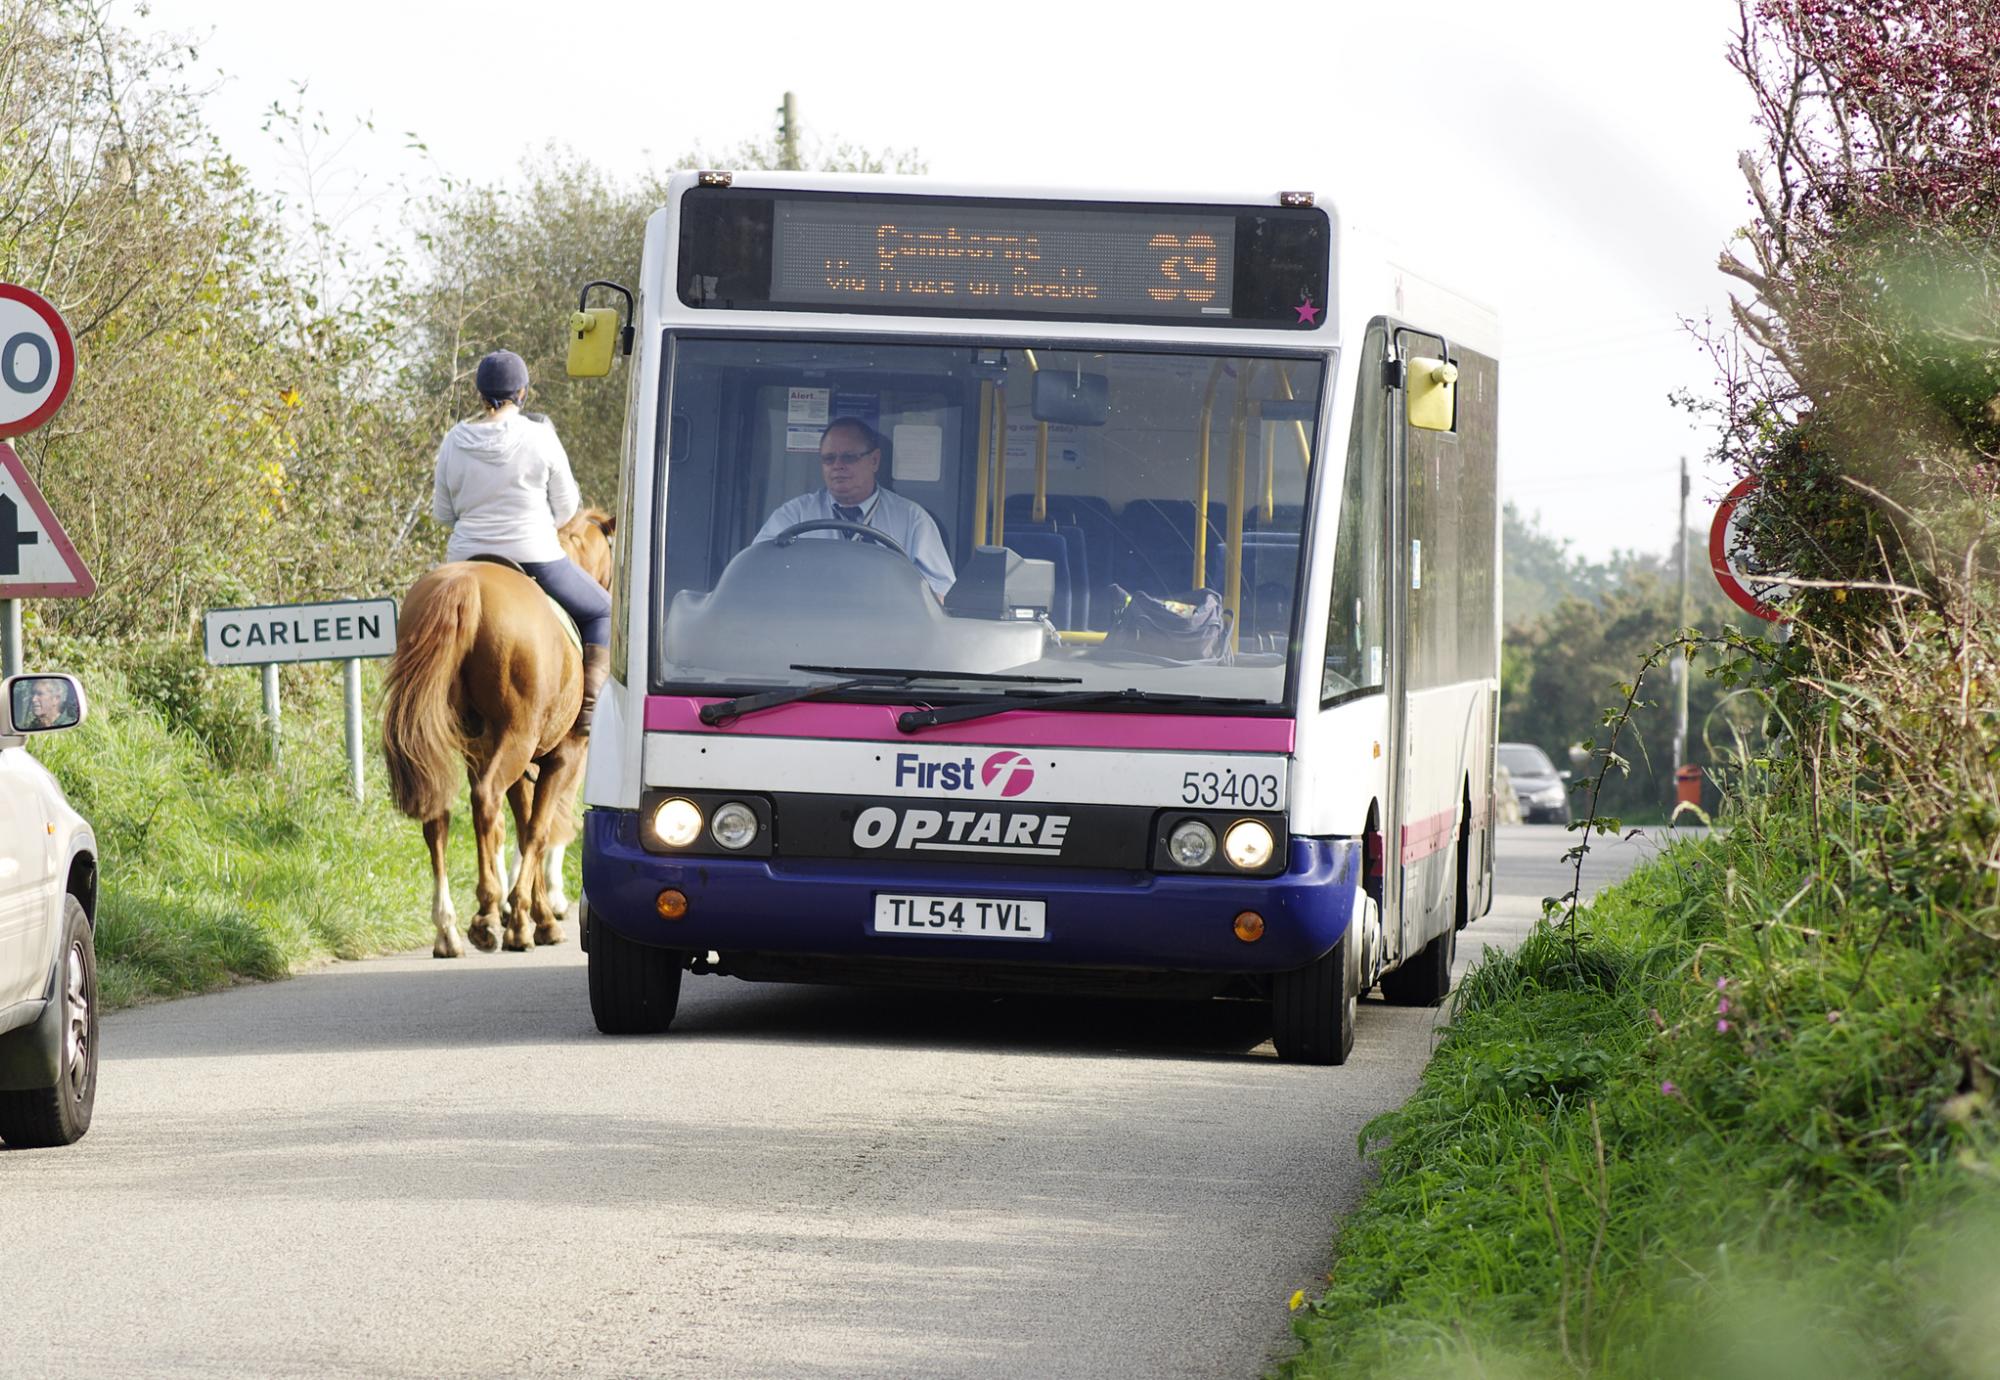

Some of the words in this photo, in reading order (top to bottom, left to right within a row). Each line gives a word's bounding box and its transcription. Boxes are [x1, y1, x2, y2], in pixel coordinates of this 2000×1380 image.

[1148, 234, 1217, 301] 39
[220, 614, 381, 648] CARLEEN
[896, 753, 975, 791] First
[1182, 772, 1278, 807] 53403
[853, 806, 1071, 853] OPTARE
[889, 899, 965, 929] TL54
[976, 902, 1031, 932] TVL
